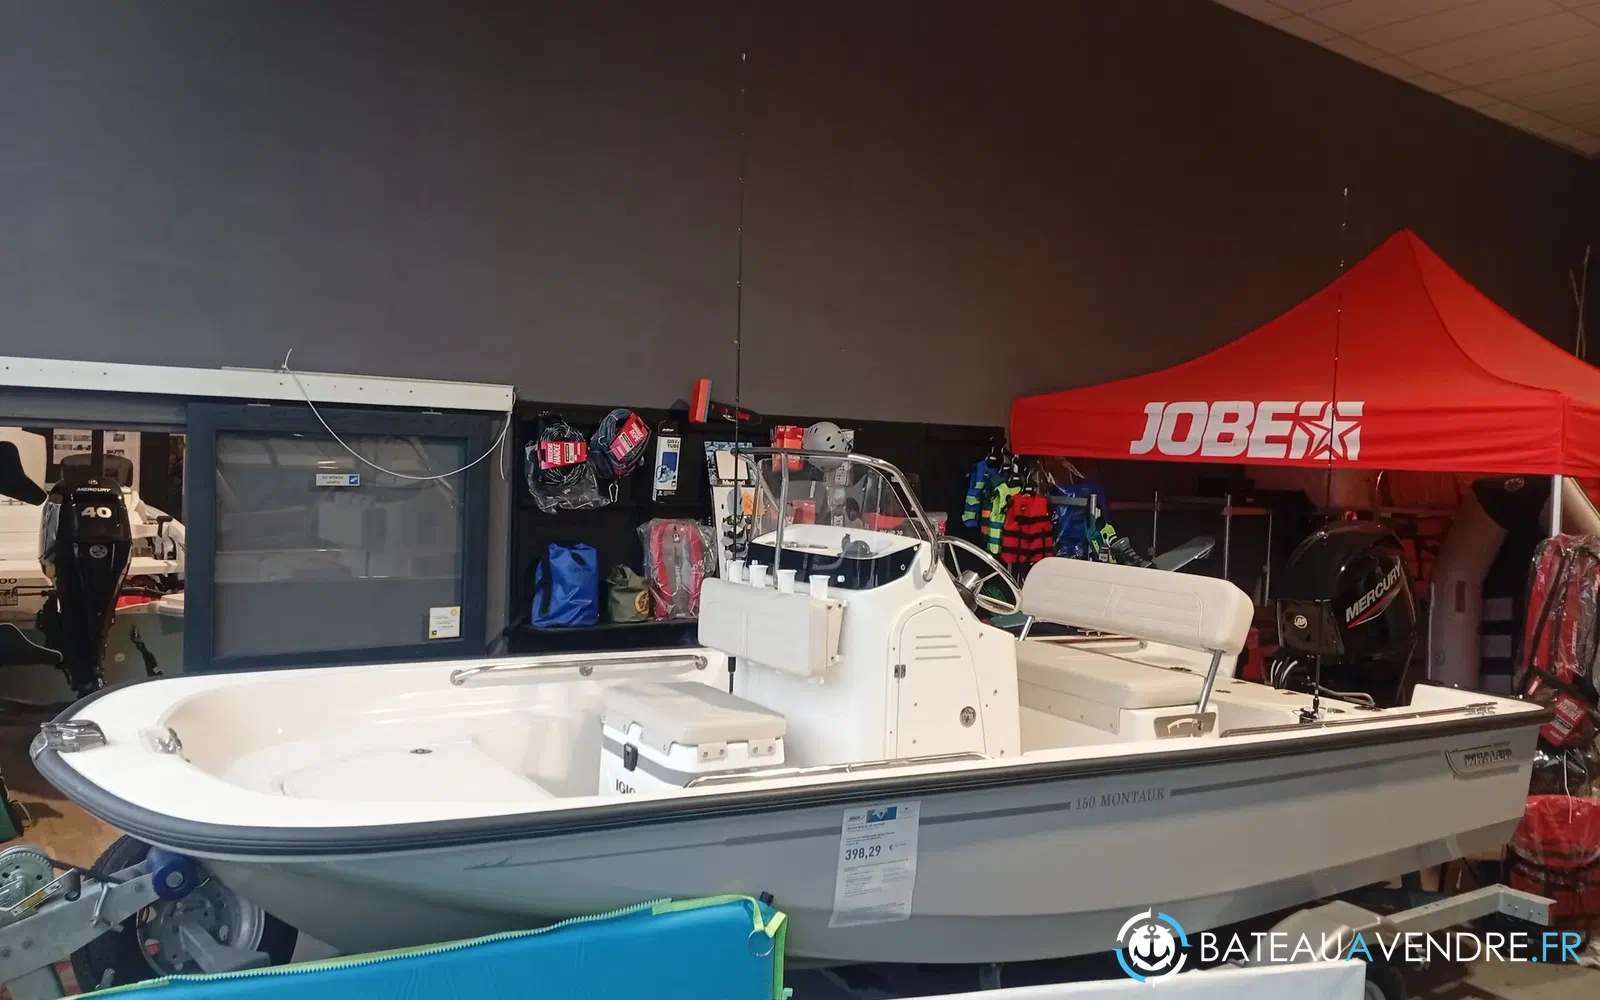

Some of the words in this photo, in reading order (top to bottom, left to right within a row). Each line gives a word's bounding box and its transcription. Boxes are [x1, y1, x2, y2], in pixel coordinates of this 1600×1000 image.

[1129, 400, 1300, 459] JOBE
[552, 443, 561, 466] HANDLE
[81, 506, 112, 519] 40
[1345, 564, 1401, 622] MERCURY
[1463, 748, 1513, 767] WHALER
[1076, 796, 1096, 811] 150
[1100, 787, 1166, 808] MONTAUK
[845, 844, 882, 861] 398,29
